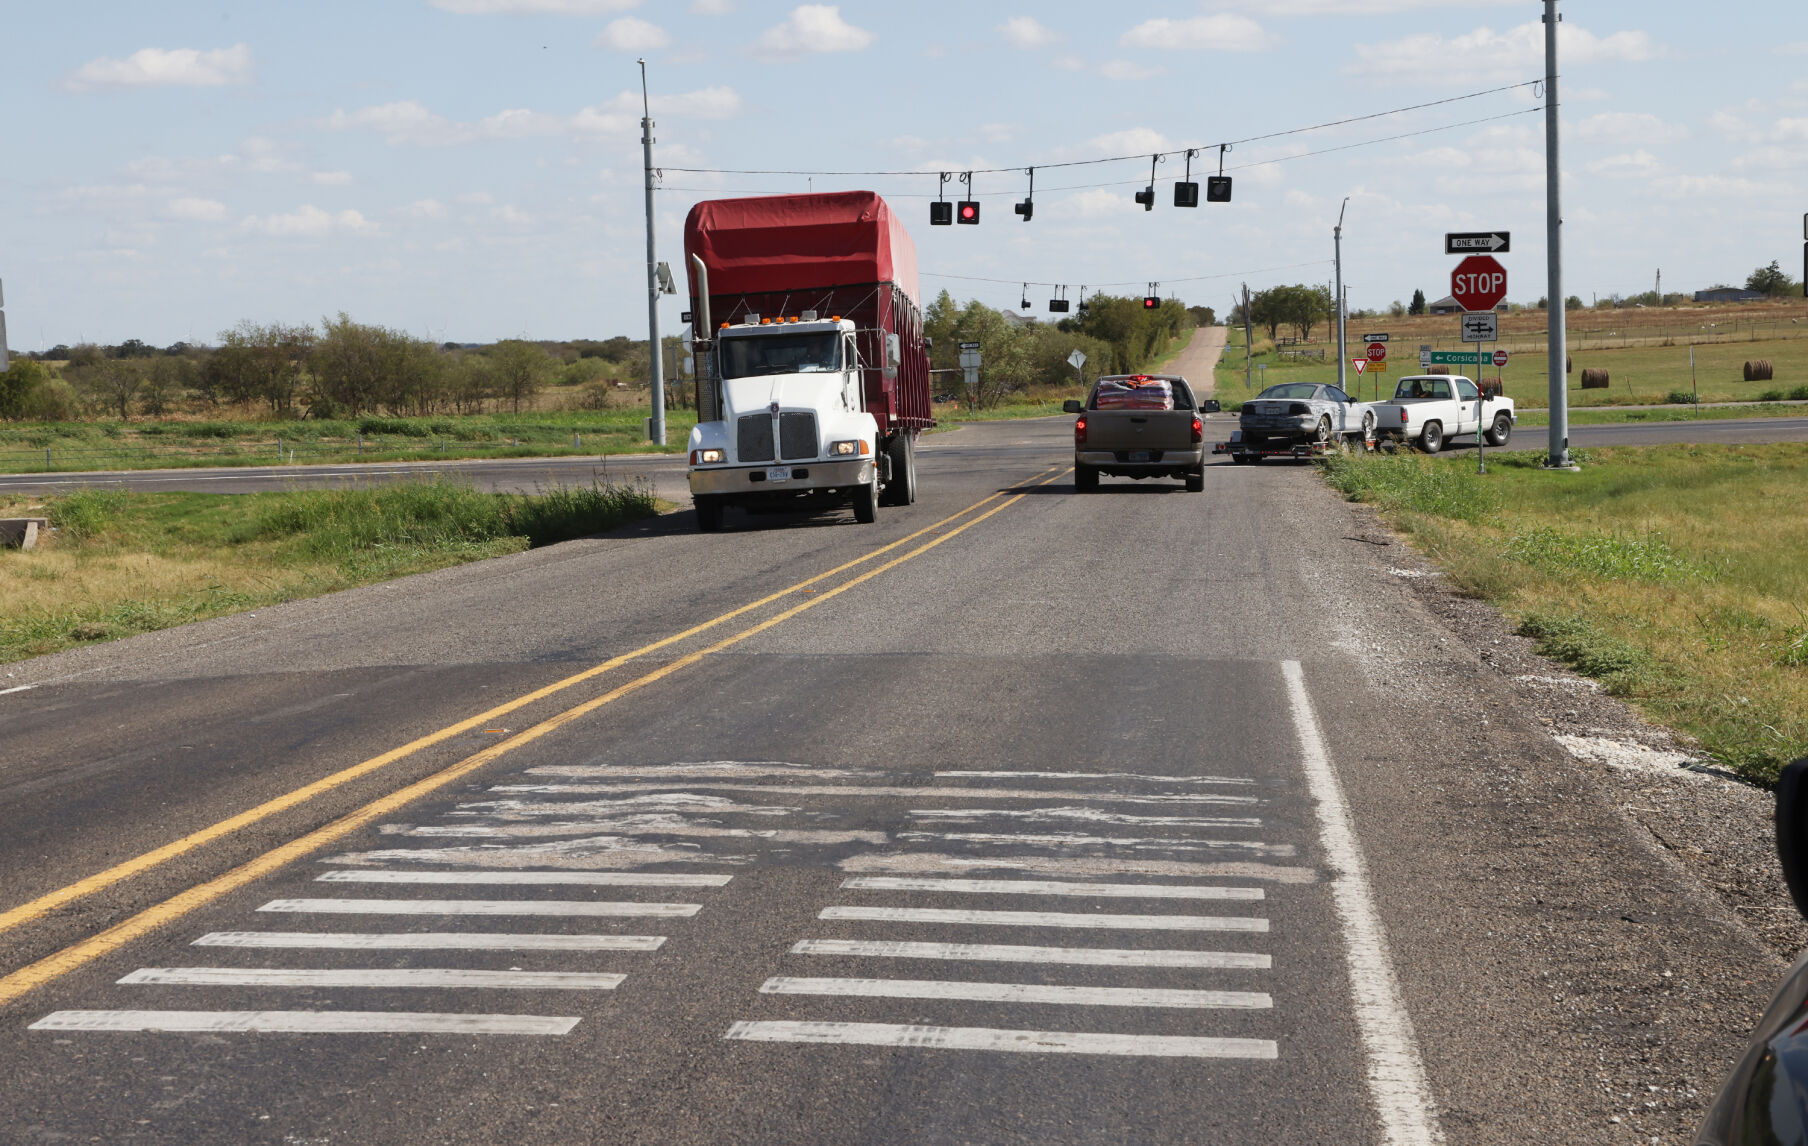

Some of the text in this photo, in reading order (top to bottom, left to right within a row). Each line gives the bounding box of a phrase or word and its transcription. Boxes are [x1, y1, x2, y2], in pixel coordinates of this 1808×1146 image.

[1456, 239, 1472, 247] ONE
[1455, 273, 1504, 295] STOP
[1367, 348, 1385, 357] STOP
